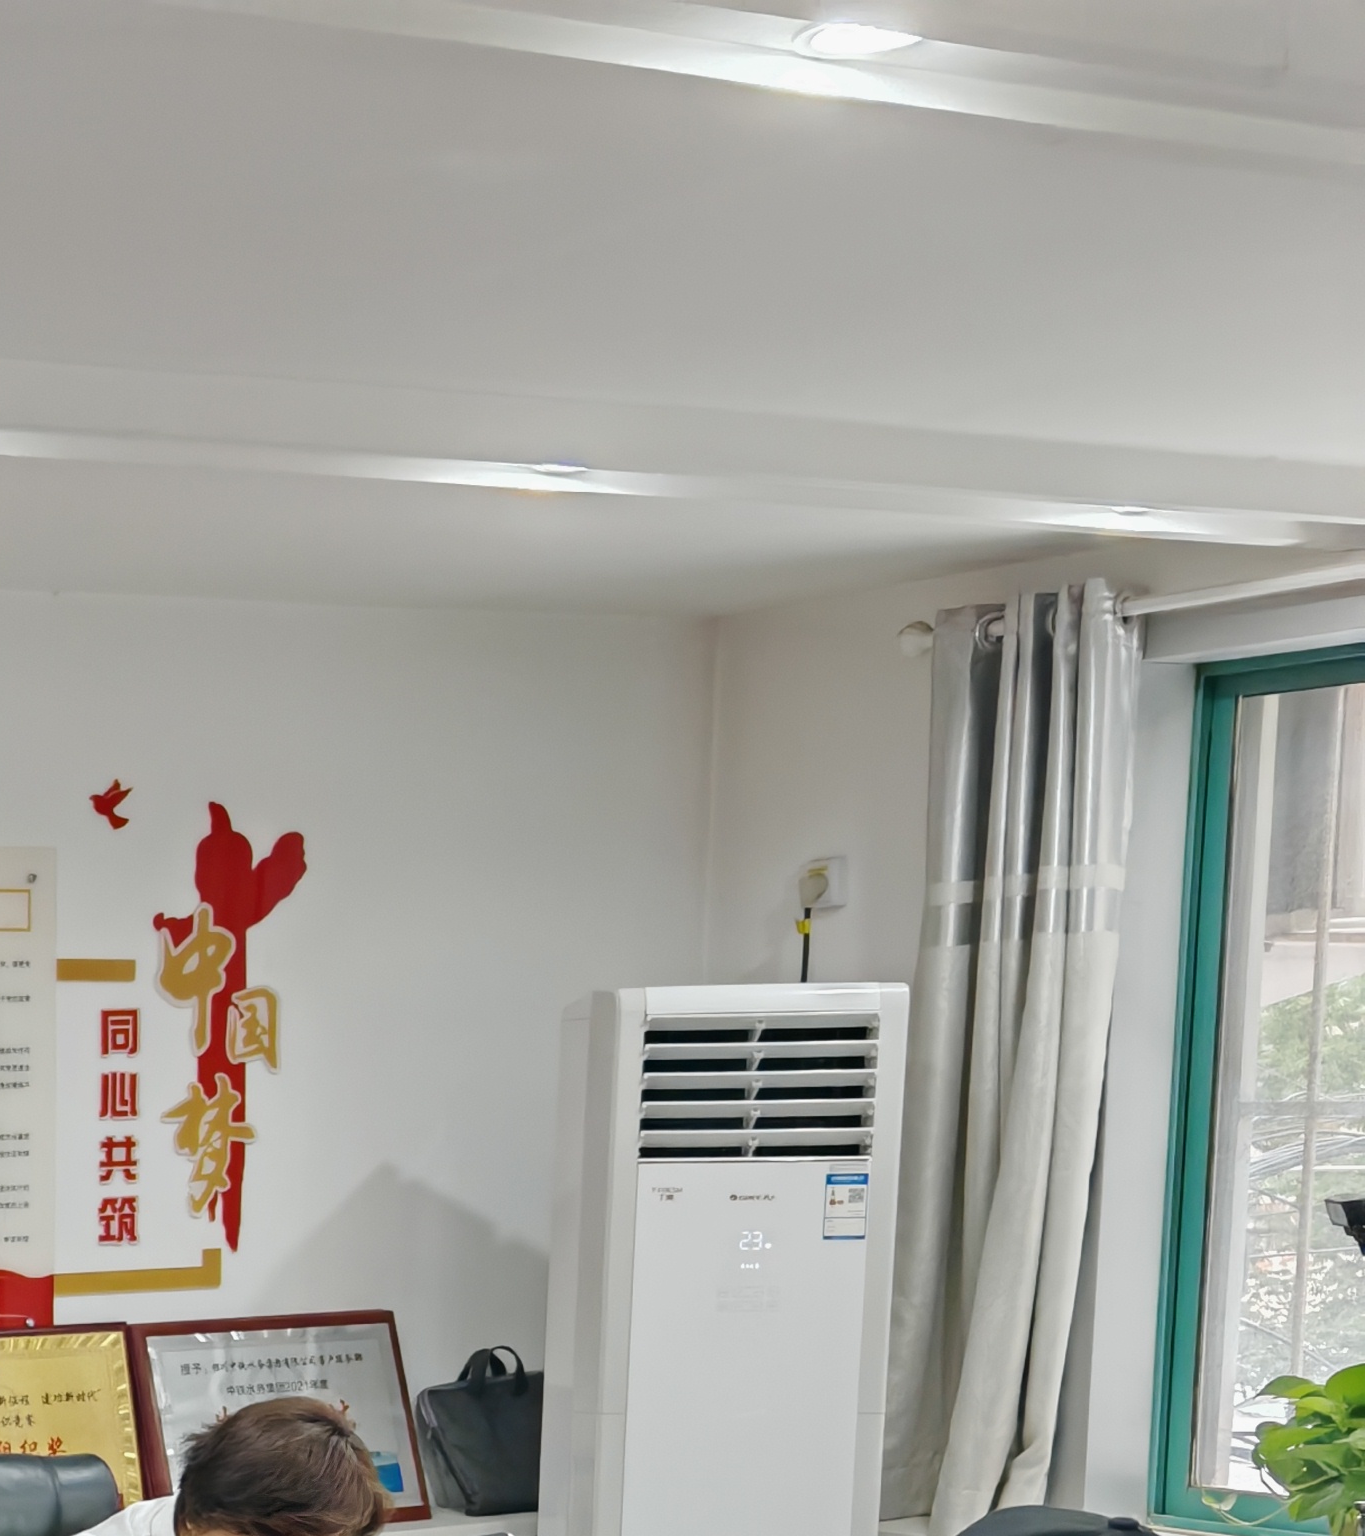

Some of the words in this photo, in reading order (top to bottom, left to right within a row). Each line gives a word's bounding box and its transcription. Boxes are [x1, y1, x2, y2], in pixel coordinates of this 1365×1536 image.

[97, 1008, 141, 1245] 同心共筑
[157, 902, 279, 1218] 中国梦
[739, 1231, 764, 1251] 23
